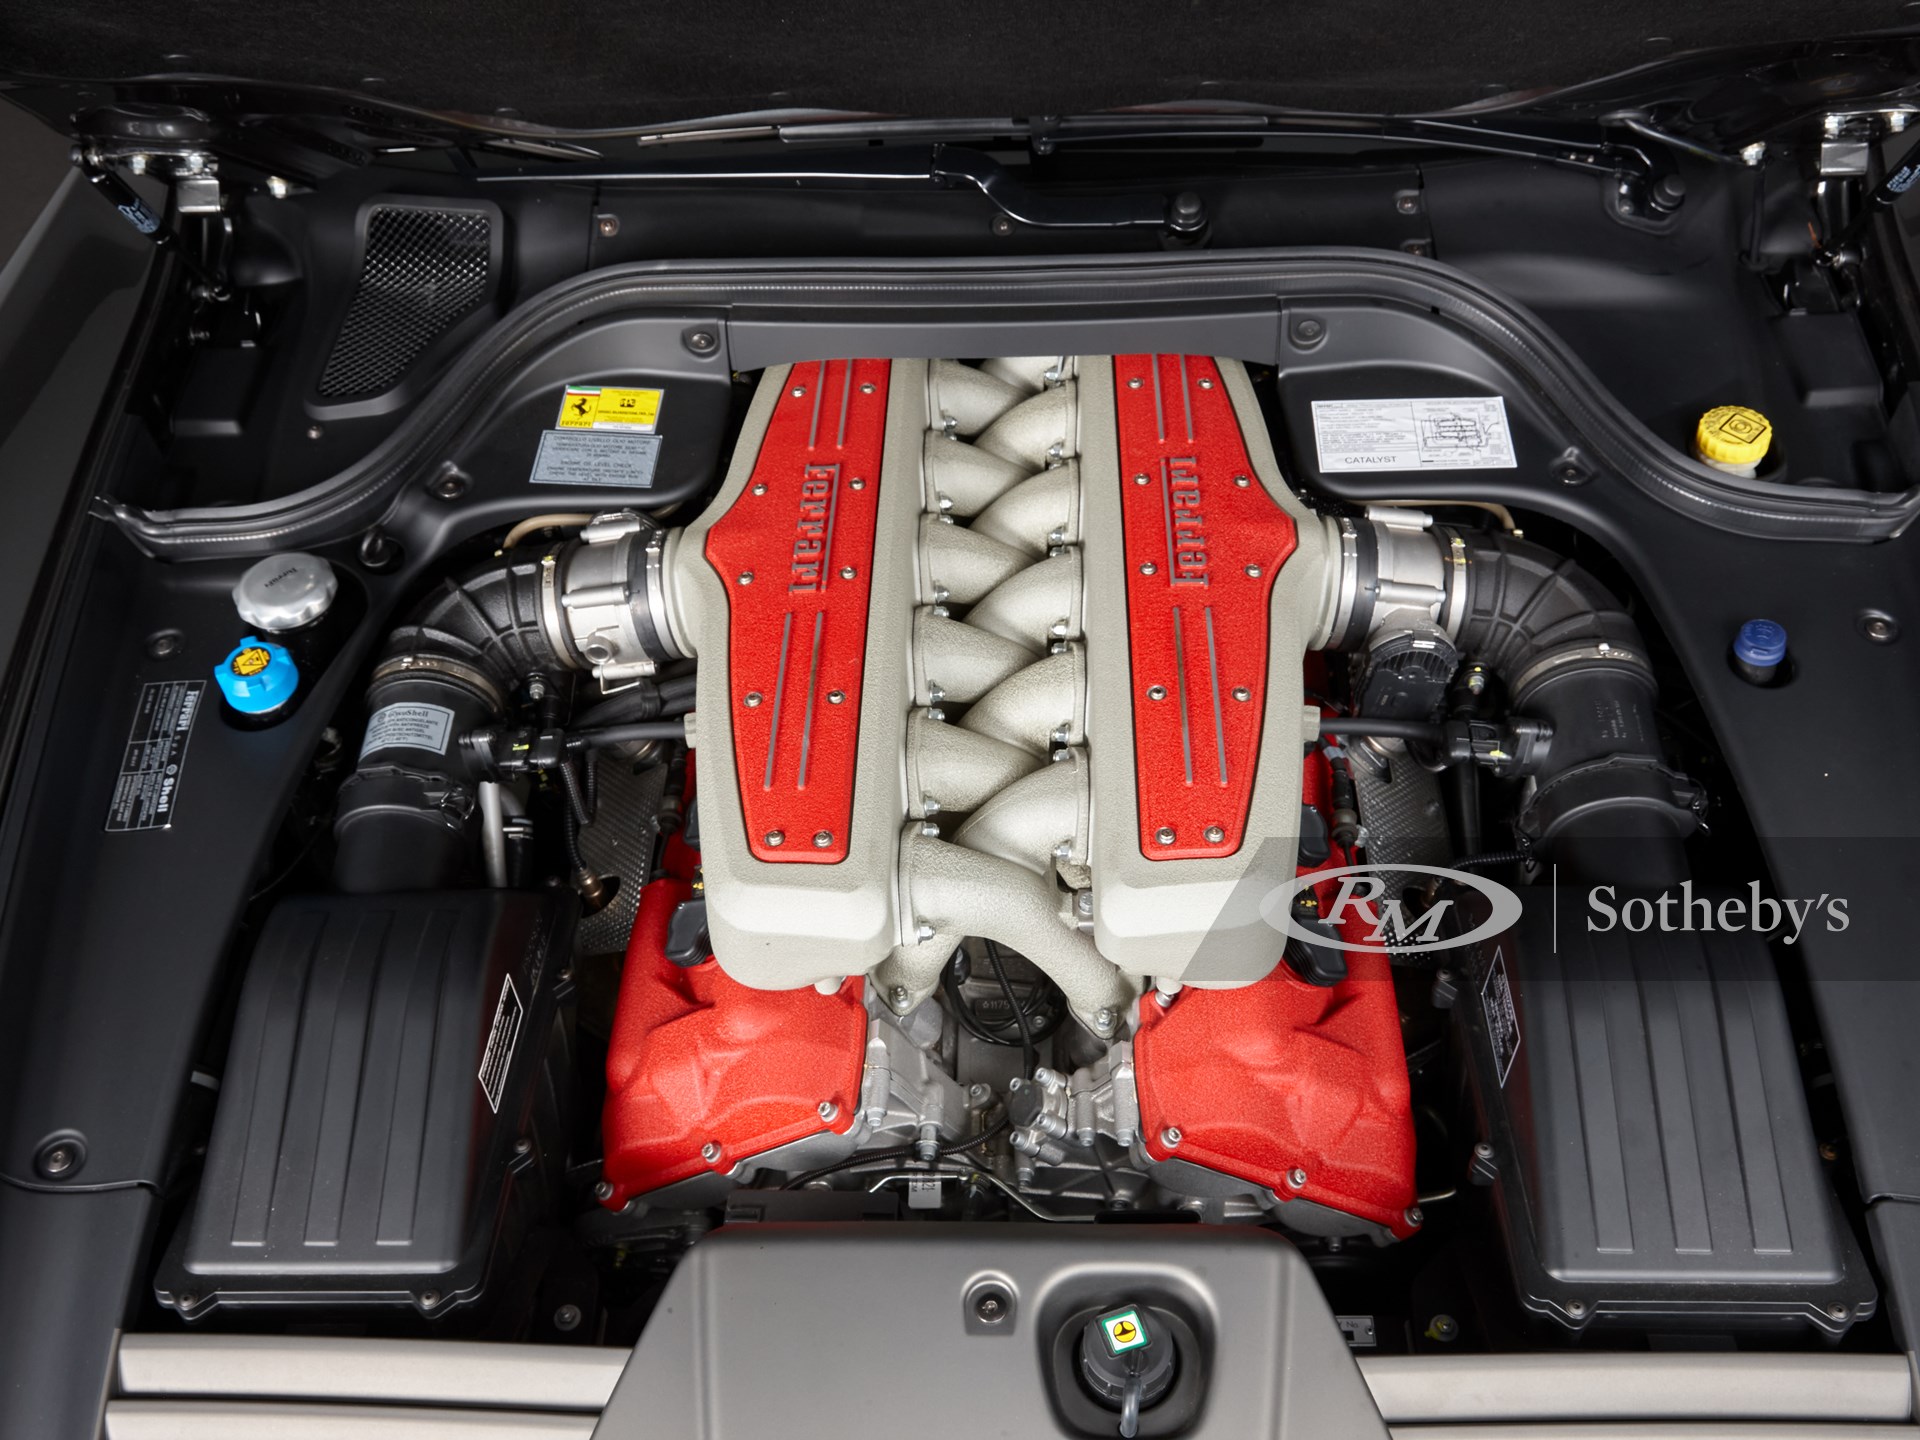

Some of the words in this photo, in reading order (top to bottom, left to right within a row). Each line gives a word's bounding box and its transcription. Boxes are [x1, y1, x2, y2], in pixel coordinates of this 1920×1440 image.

[1344, 455, 1397, 465] CATALYST
[789, 463, 840, 593] Ferrari
[1160, 457, 1210, 587] Ferrari
[176, 690, 200, 731] Ferrari
[157, 777, 175, 812] Shell
